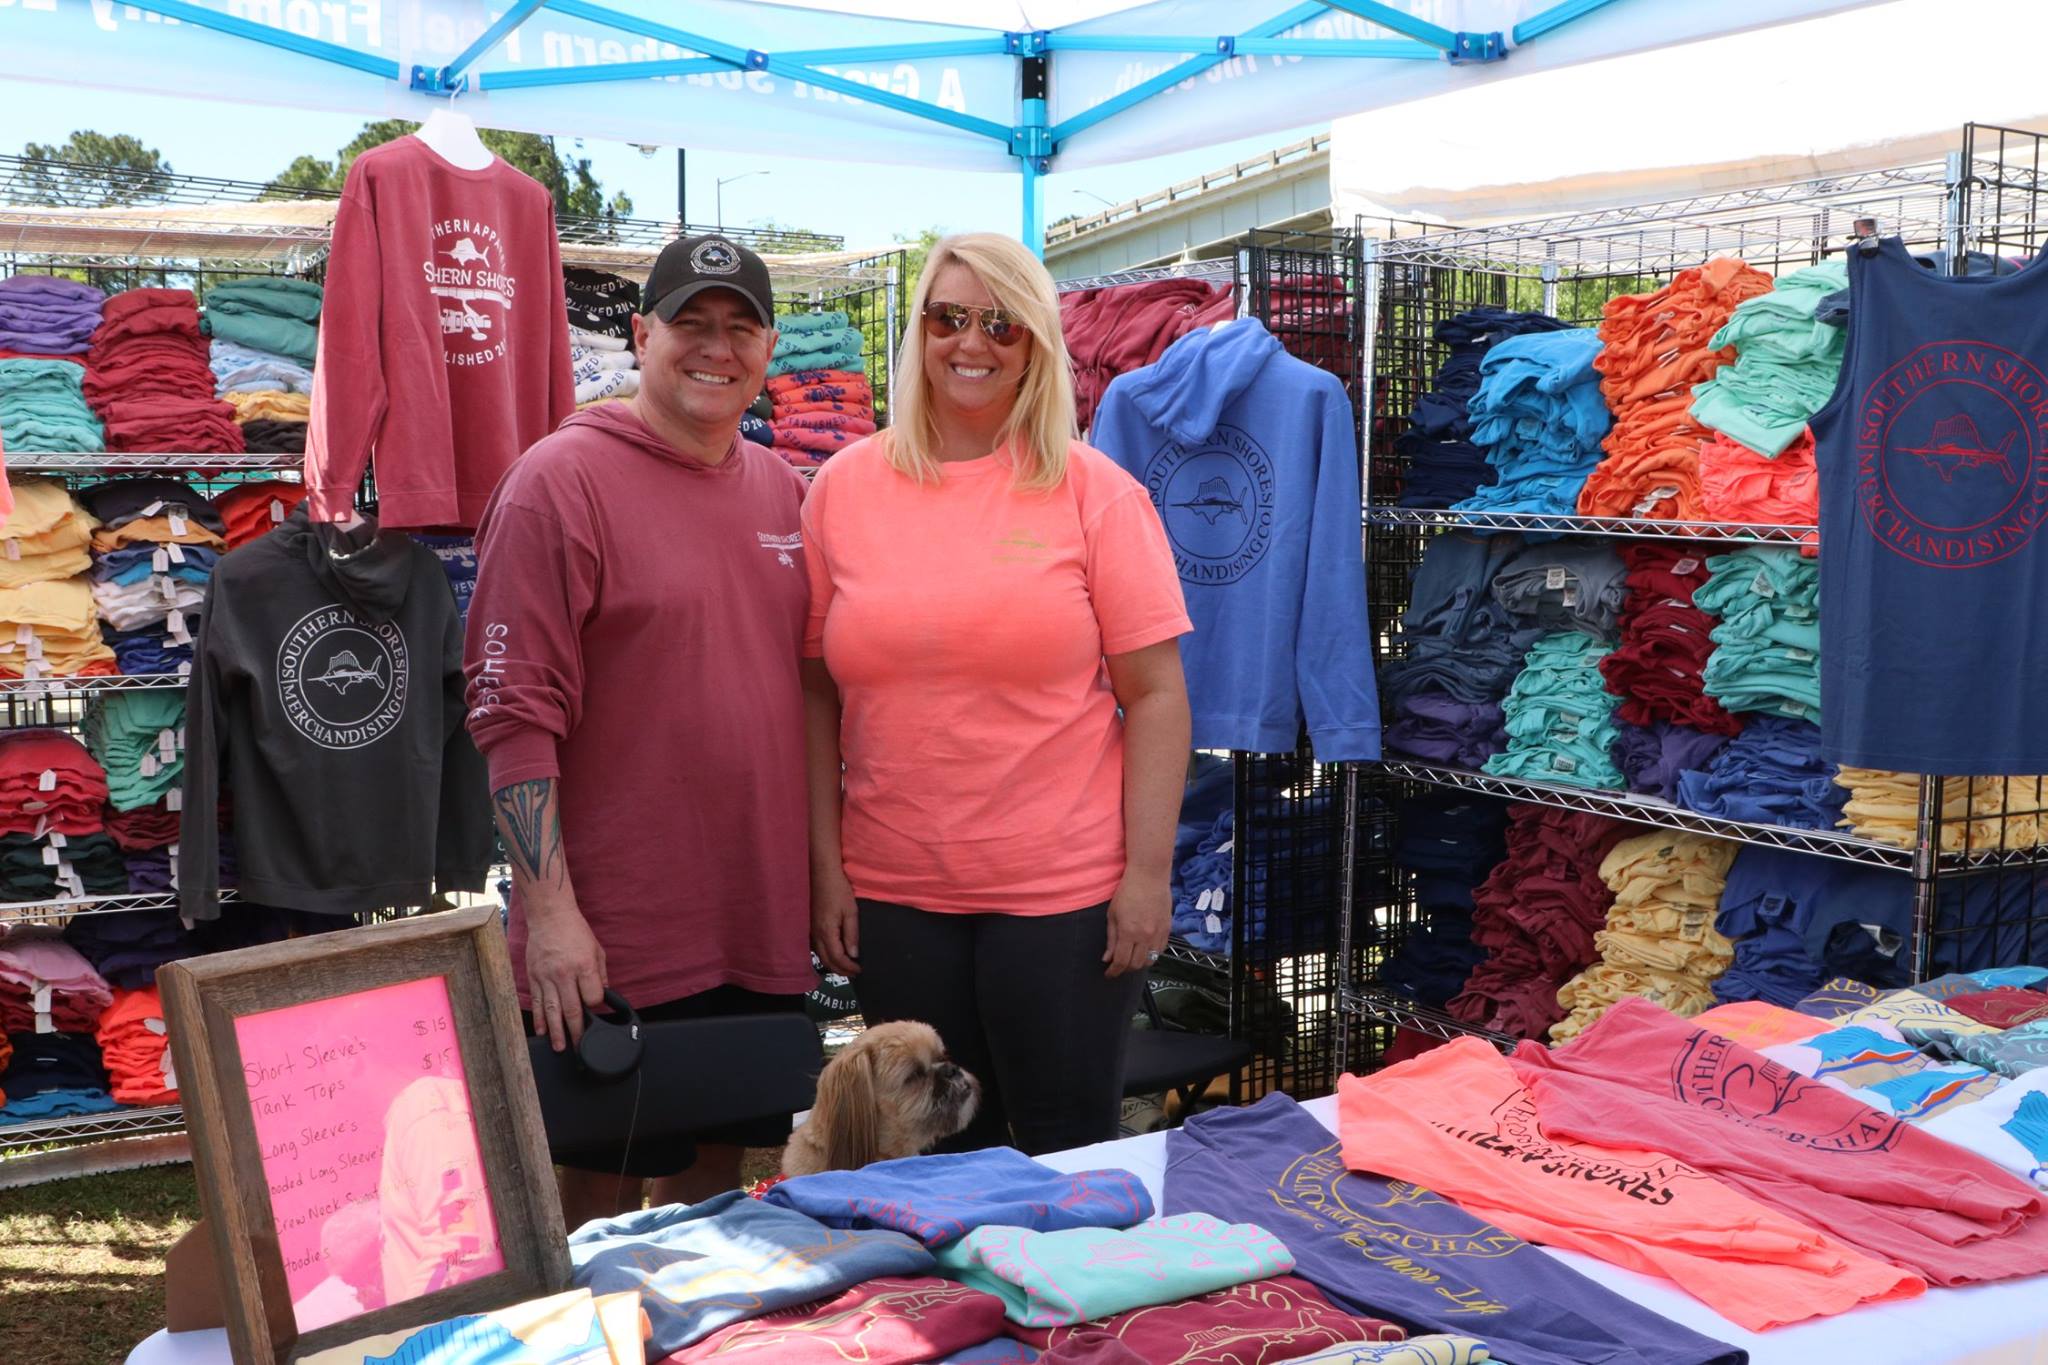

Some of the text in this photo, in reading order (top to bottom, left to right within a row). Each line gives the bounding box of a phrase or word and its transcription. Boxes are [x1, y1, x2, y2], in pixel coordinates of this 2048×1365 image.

[1234, 436, 1273, 506] SHORES
[281, 609, 356, 679] SOUTHERN
[283, 683, 401, 745] MERCHANDISING
[243, 1052, 296, 1088] Short
[302, 1035, 368, 1070] Sleeve's
[249, 1093, 297, 1119] Tank
[303, 1079, 346, 1101] Tops
[260, 1120, 359, 1161] Long Sleeve's
[309, 1166, 339, 1184] Long
[273, 1214, 306, 1236] Crew
[307, 1199, 342, 1220] Neck
